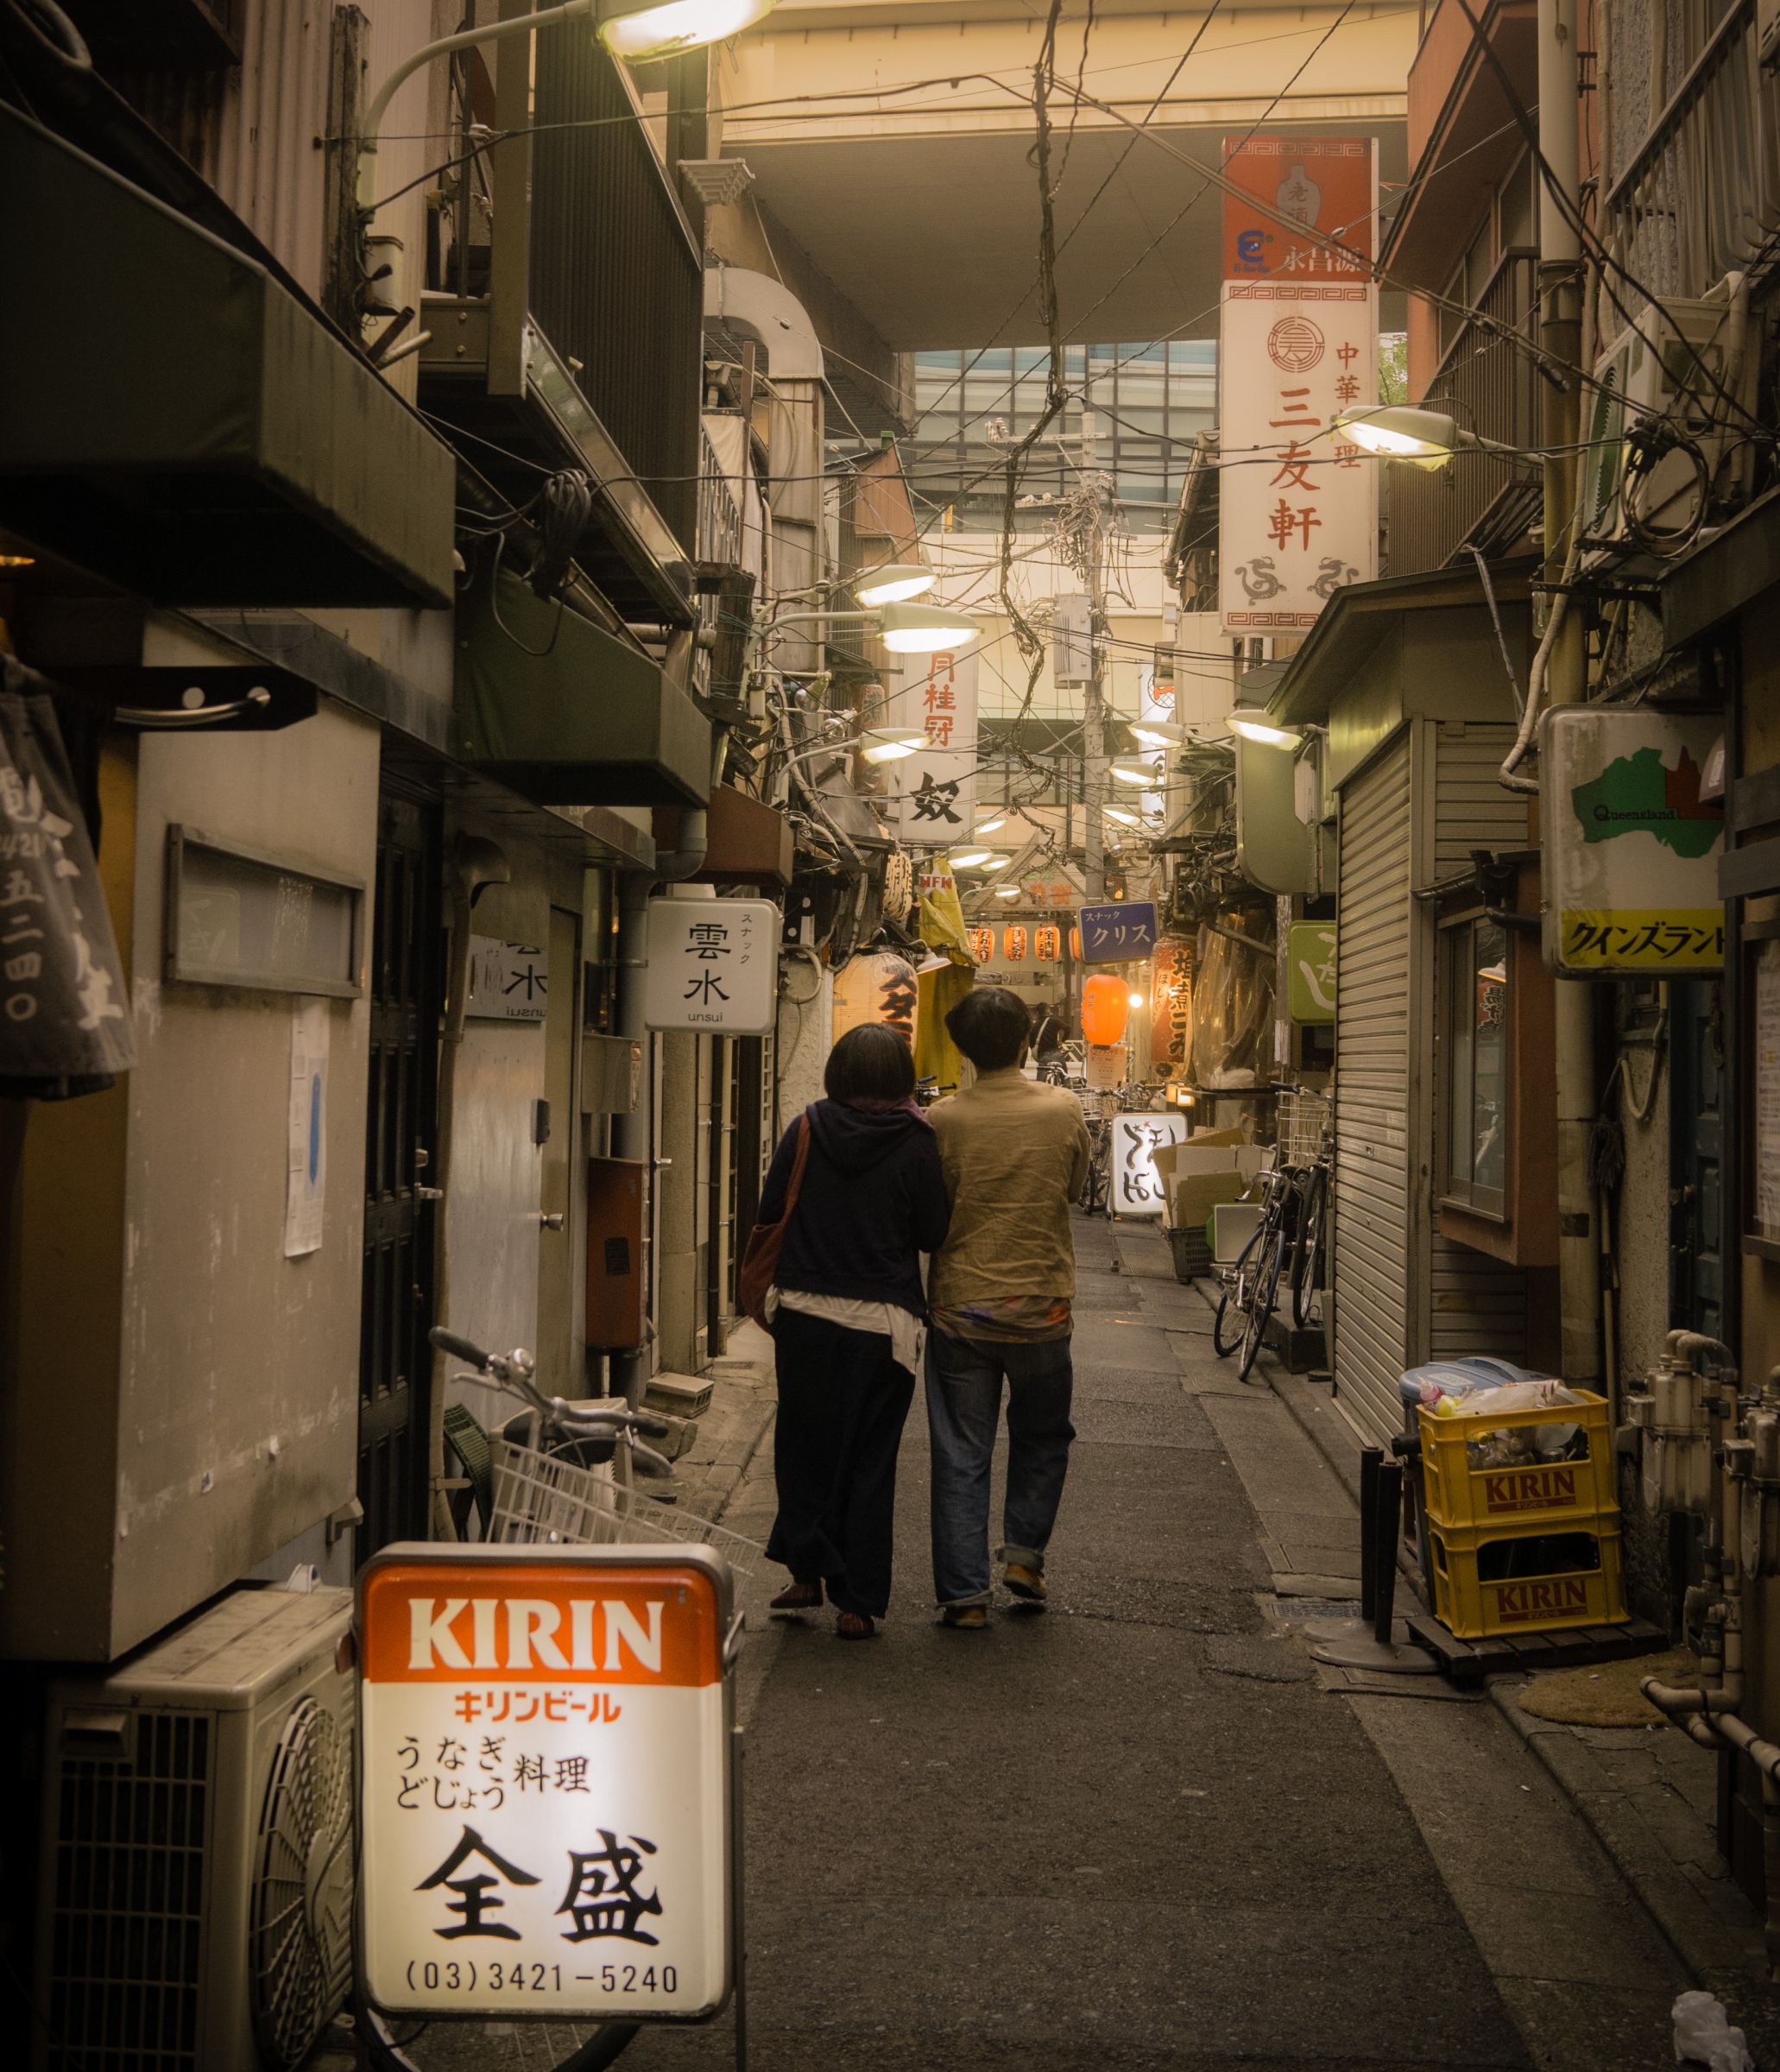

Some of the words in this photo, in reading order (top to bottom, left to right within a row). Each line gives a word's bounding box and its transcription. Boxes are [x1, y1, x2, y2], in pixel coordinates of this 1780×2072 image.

[1335, 341, 1361, 469] 中華理
[1268, 387, 1322, 552] 三友軒
[923, 651, 956, 747] 月桂冠
[909, 771, 963, 824] 奴
[1594, 805, 1675, 821] Queensland
[1085, 911, 1120, 922] スナック
[740, 913, 753, 965] スナック
[1092, 924, 1152, 948] クリス
[683, 923, 732, 1006] 雲水
[687, 1012, 723, 1023] unsui
[1485, 1470, 1575, 1503] KIRIN
[1497, 1580, 1587, 1614] KIRIN
[407, 1598, 665, 1673] KIRIN
[455, 1690, 622, 1724] キリンビール
[396, 1735, 506, 1771] うなぎ
[514, 1753, 591, 1794] 料理
[396, 1776, 507, 1810] どじょう
[413, 1824, 663, 1947] 全盛
